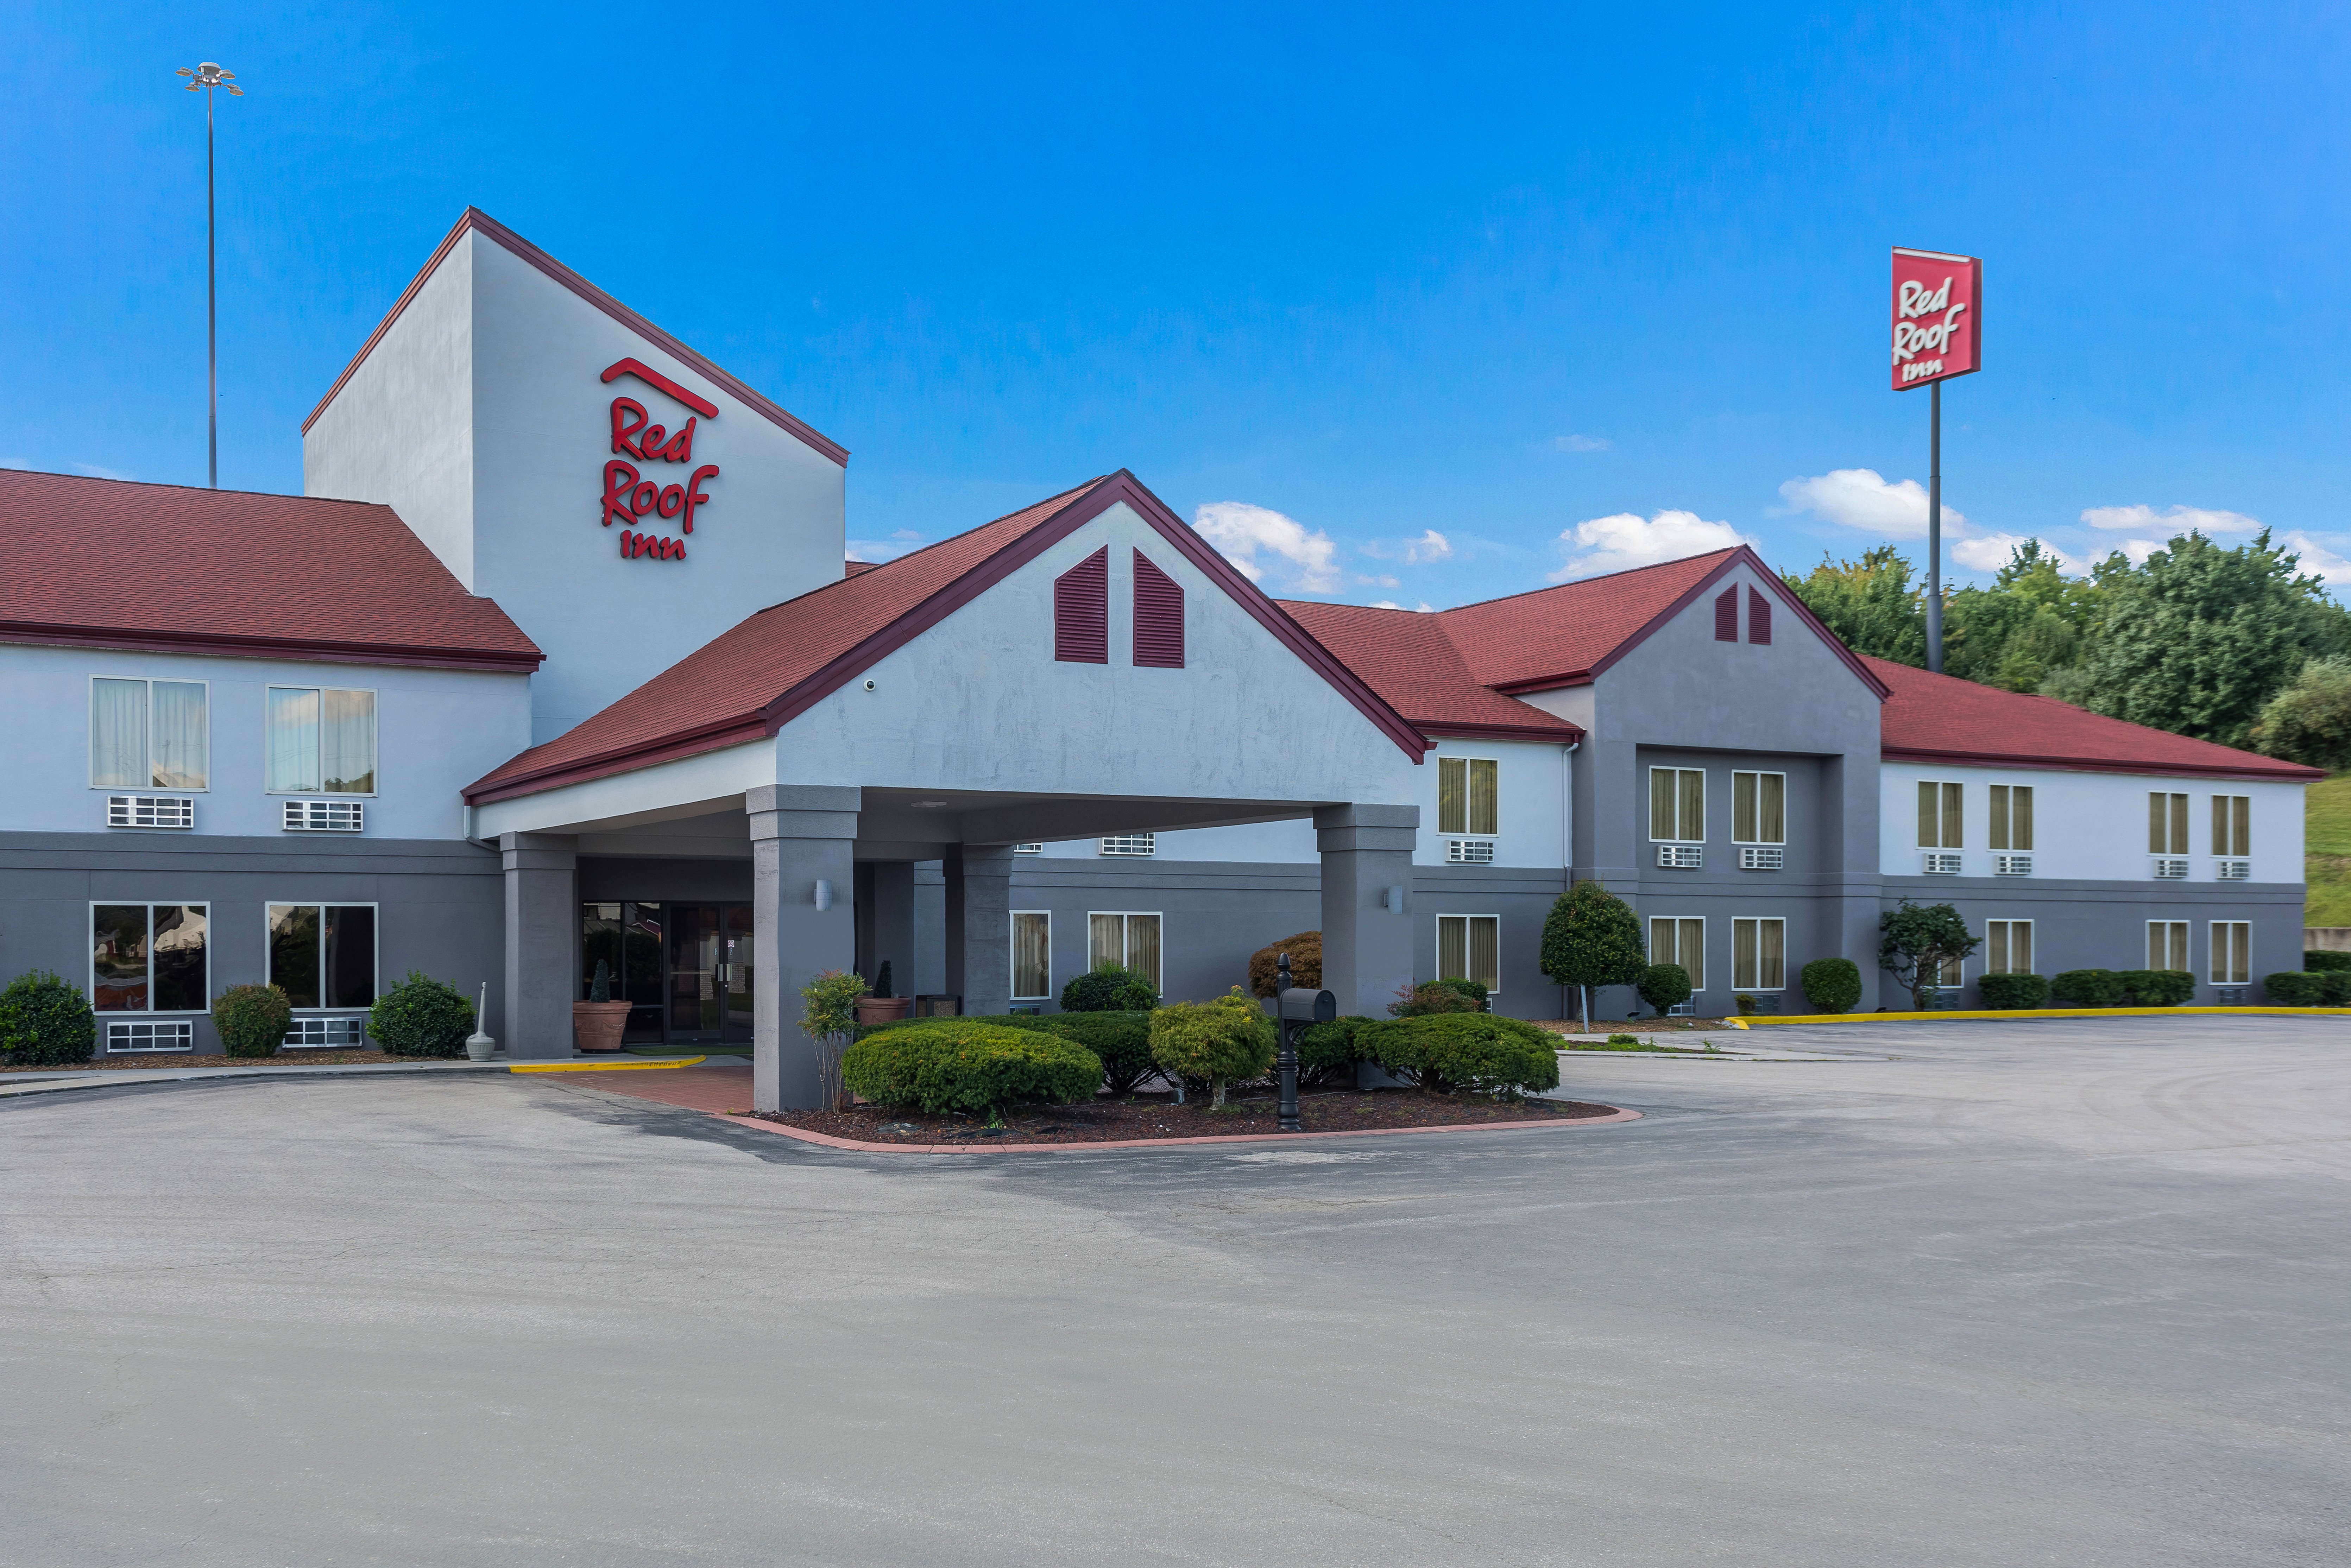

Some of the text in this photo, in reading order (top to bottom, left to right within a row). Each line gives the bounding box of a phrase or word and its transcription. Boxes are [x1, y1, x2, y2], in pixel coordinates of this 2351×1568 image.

[1899, 277, 1953, 318] Red
[1892, 303, 1966, 366] Roof
[610, 397, 697, 463] Red
[600, 460, 720, 534] Roof
